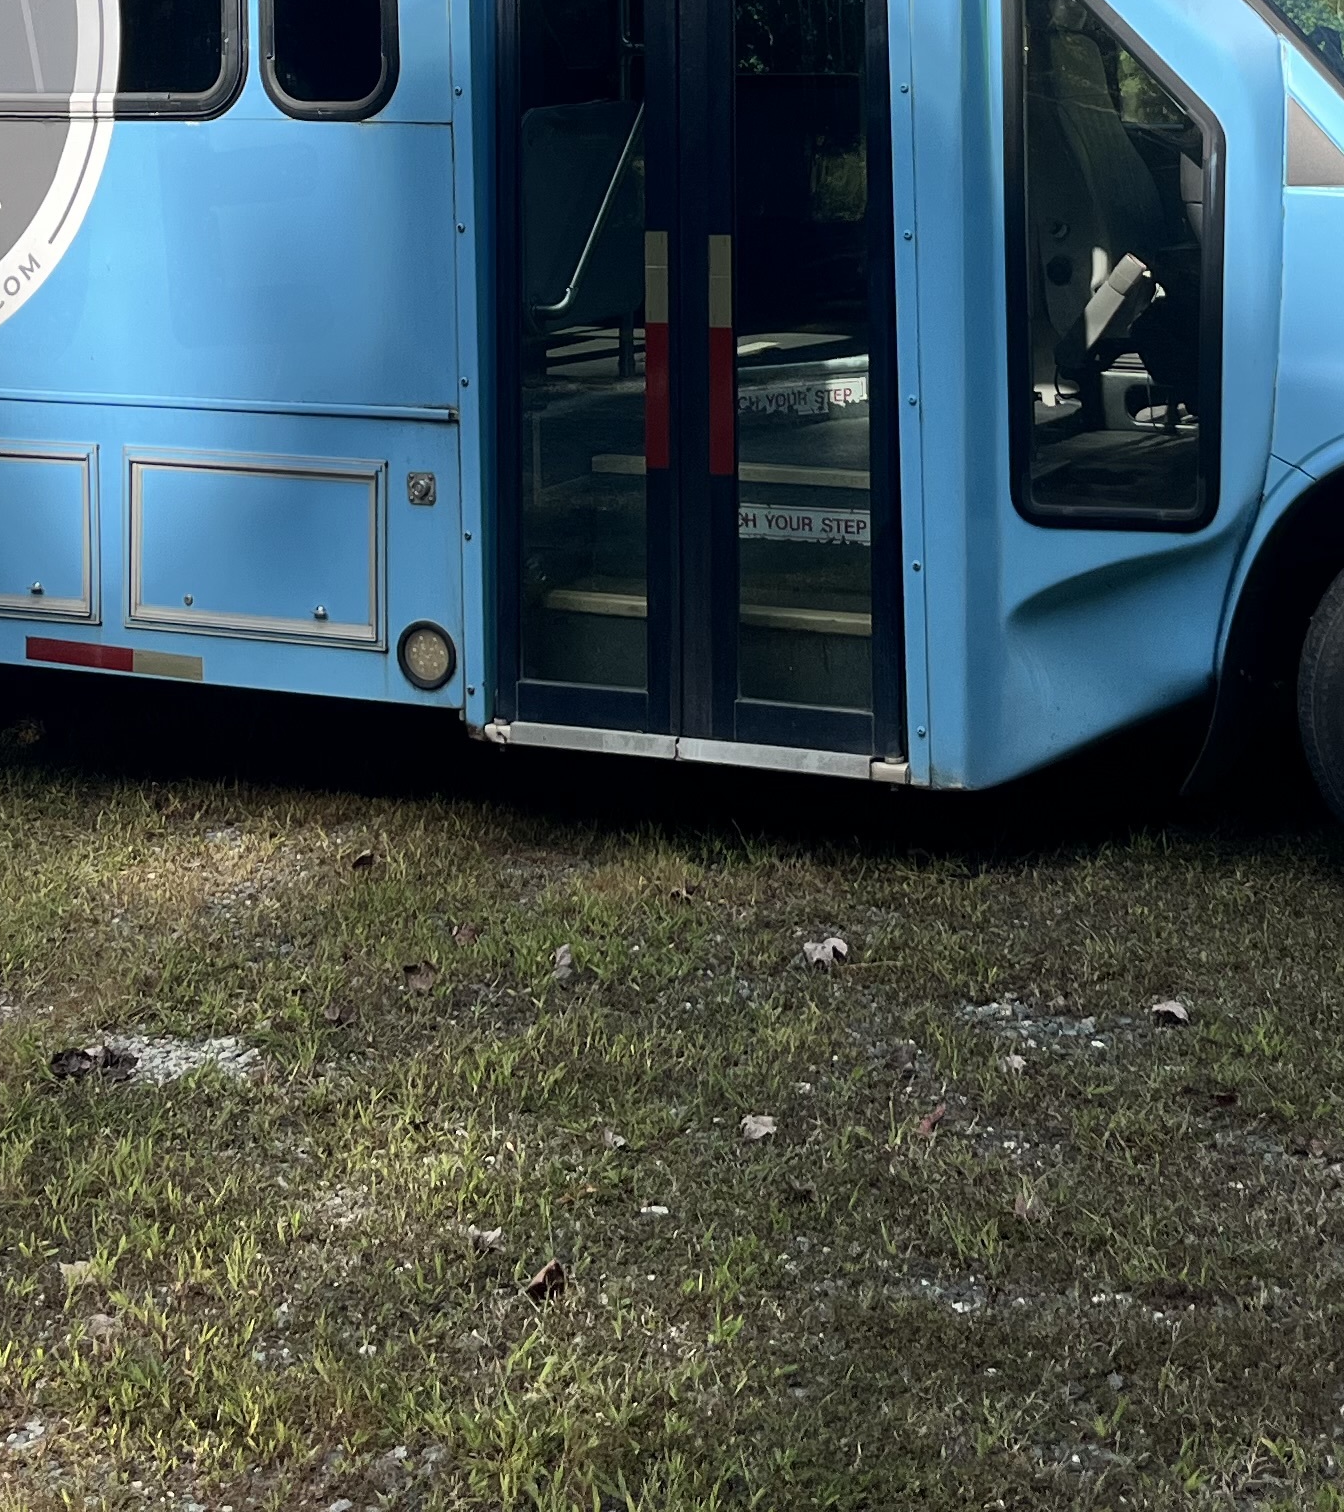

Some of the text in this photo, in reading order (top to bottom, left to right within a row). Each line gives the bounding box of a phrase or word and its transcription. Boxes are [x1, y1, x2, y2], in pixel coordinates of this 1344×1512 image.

[765, 389, 808, 408] YOUR
[814, 387, 853, 405] STEP
[765, 514, 813, 532] YOUR
[821, 517, 867, 535] STEP
